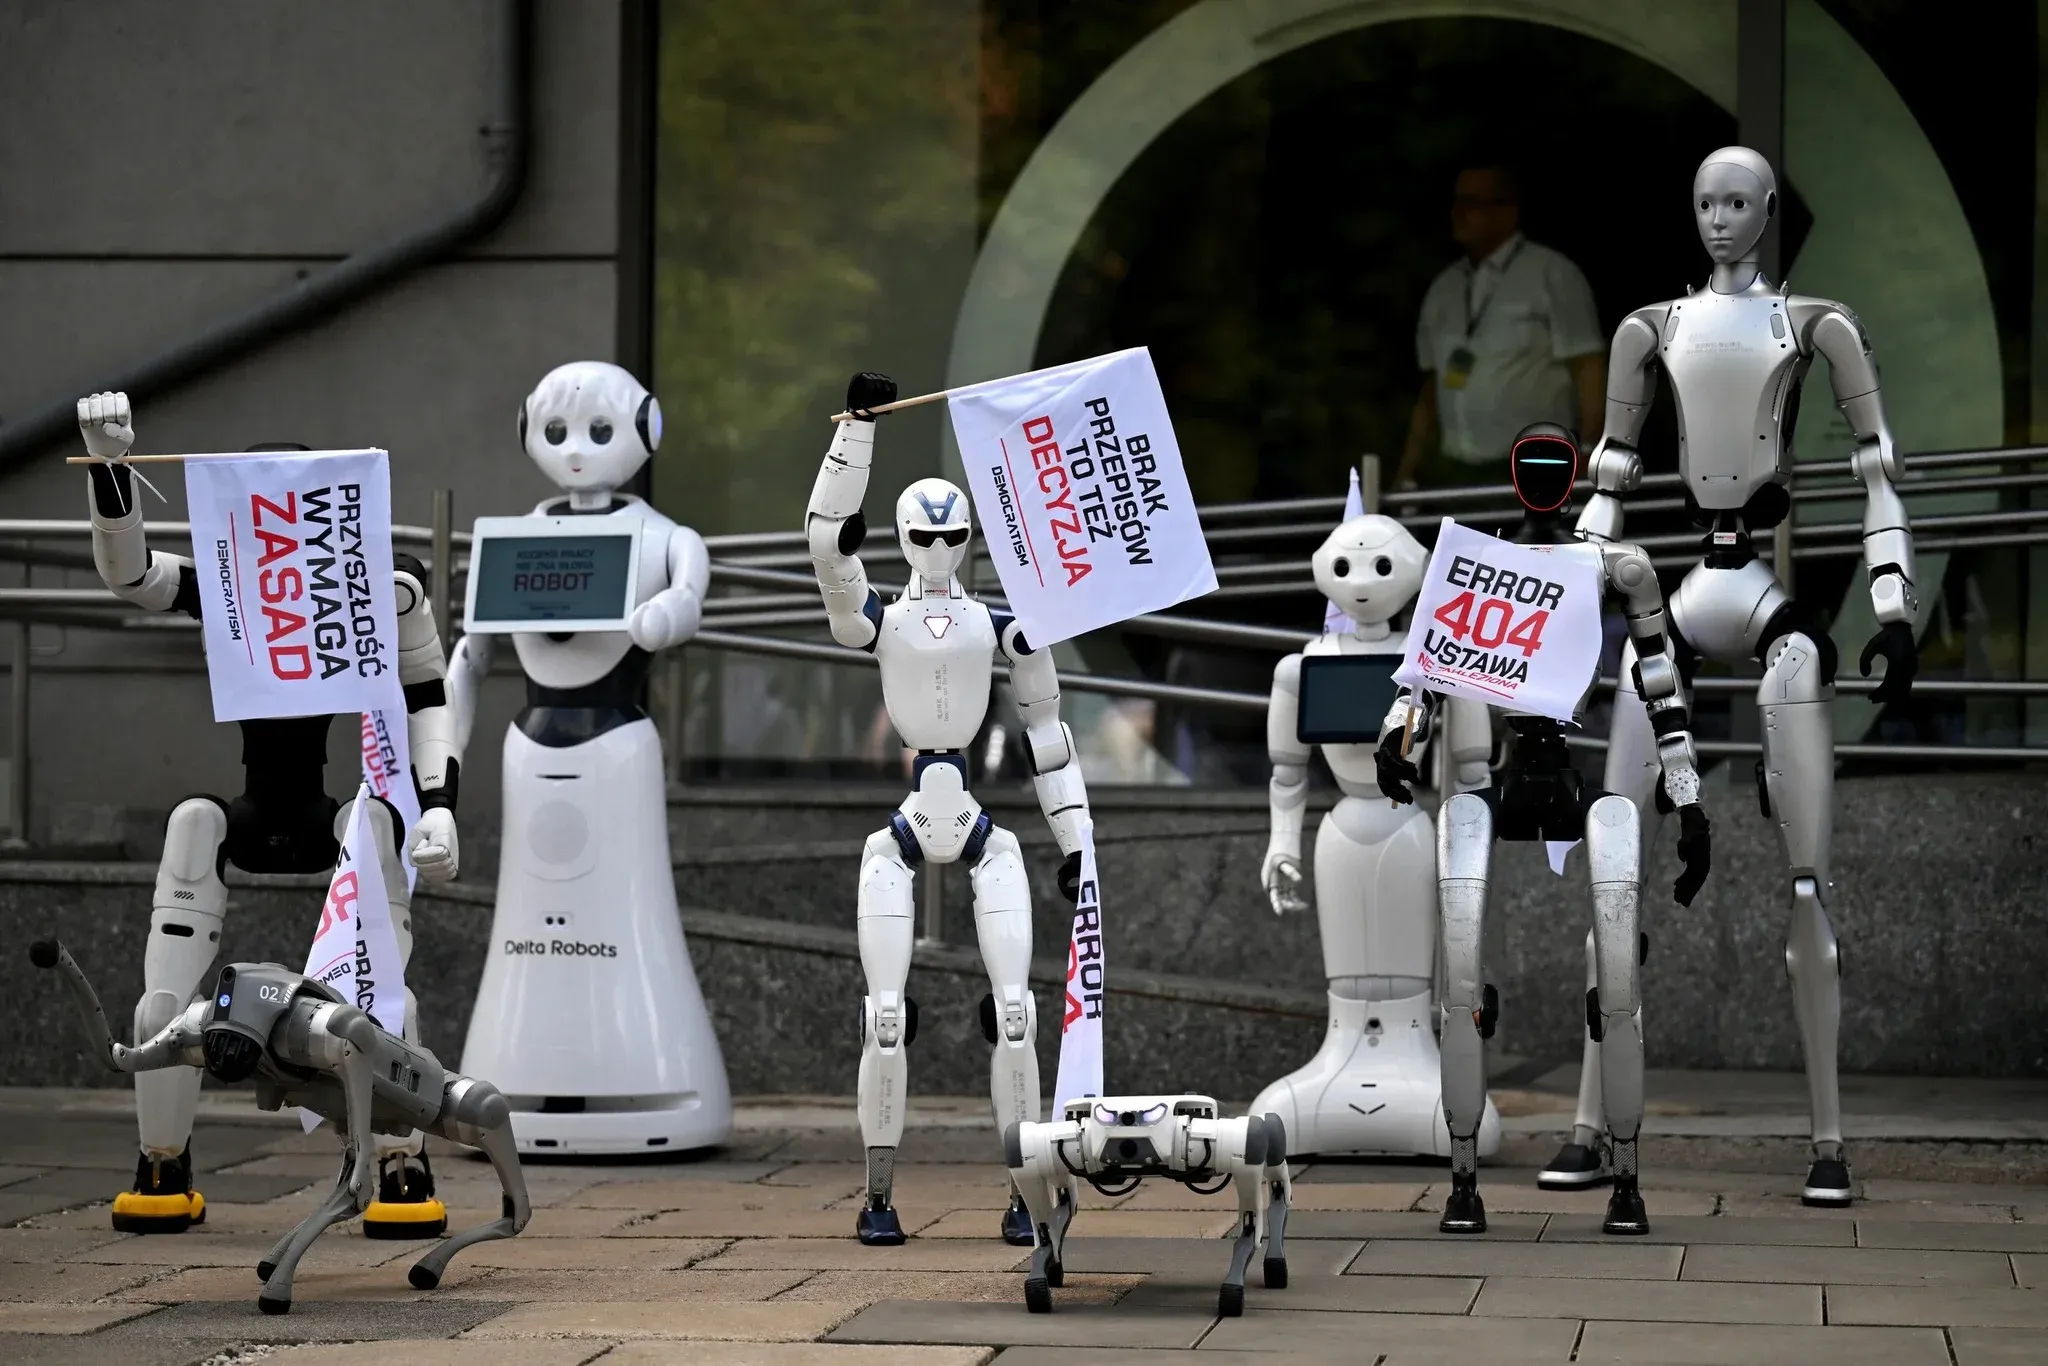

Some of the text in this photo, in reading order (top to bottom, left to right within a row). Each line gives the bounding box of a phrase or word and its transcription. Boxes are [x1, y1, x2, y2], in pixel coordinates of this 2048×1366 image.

[991, 465, 1030, 567] DEMOCRATISM
[1021, 414, 1093, 588] DECYZJA
[1065, 438, 1119, 544] TO TEŻ
[1084, 396, 1153, 566] PRZEPISÓW
[1125, 433, 1170, 517] BRAK
[216, 539, 242, 641] DEMOCRATISM
[250, 491, 313, 681] ZASAD
[302, 486, 351, 681] WYMAGA
[338, 483, 388, 678] PRZYSZŁOŚĆ
[514, 572, 594, 592] ROBOT
[1433, 591, 1550, 657] 404
[1446, 555, 1565, 611] ERROR
[1423, 628, 1529, 683] USTAWA
[260, 985, 279, 1001] 02
[504, 940, 618, 958] Delta Robots
